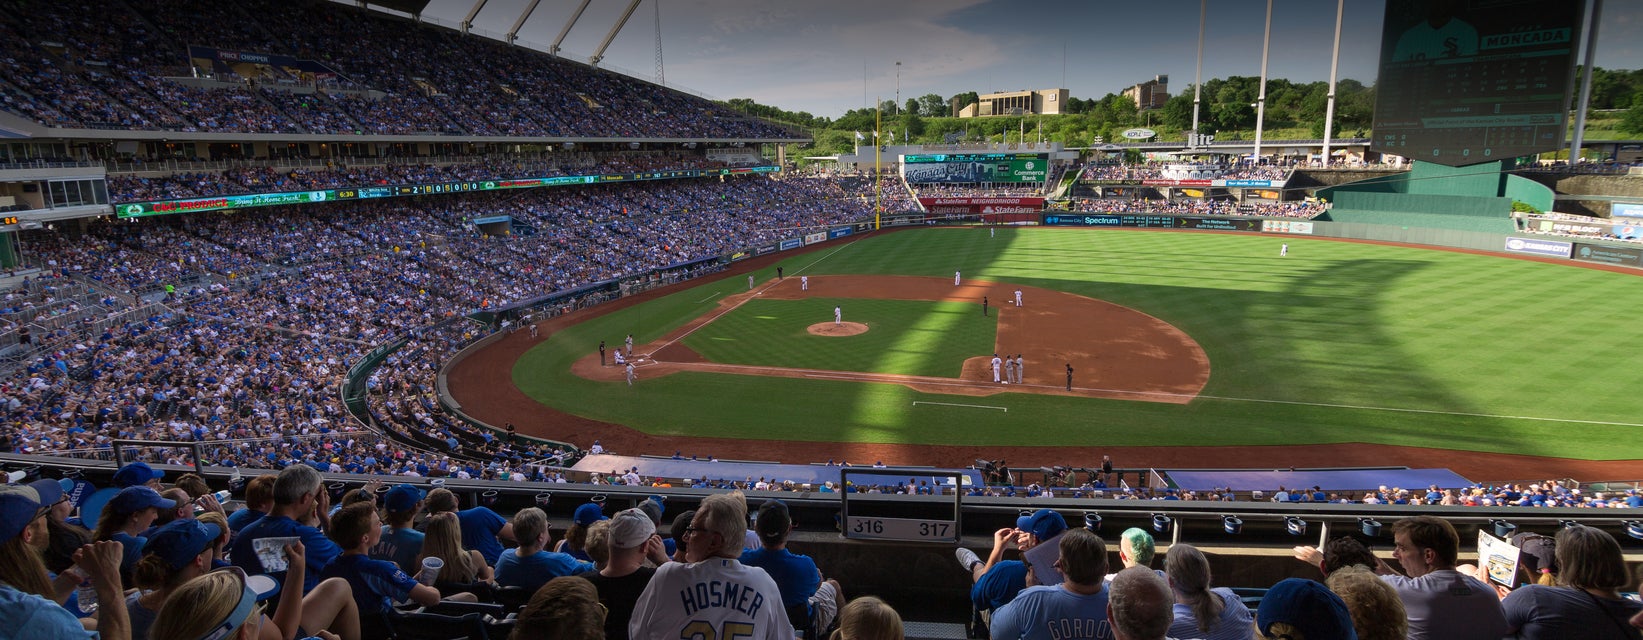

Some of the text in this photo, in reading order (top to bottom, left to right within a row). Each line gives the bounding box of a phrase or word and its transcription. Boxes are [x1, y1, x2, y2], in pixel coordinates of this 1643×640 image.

[1487, 30, 1565, 46] MONCADA
[219, 51, 270, 63] PRICE CHOPPER
[1008, 142, 1018, 150] 20
[1046, 141, 1051, 149] 5
[413, 186, 418, 194] 2
[179, 199, 229, 211] PRODUCE
[1085, 216, 1118, 224] Spectrum
[1552, 245, 1569, 253] CITY
[69, 482, 86, 507] aetna
[854, 520, 949, 537] 316 317
[370, 541, 399, 559] CAIN
[680, 580, 764, 620] HOSMER
[1047, 618, 1113, 640] GORDO
